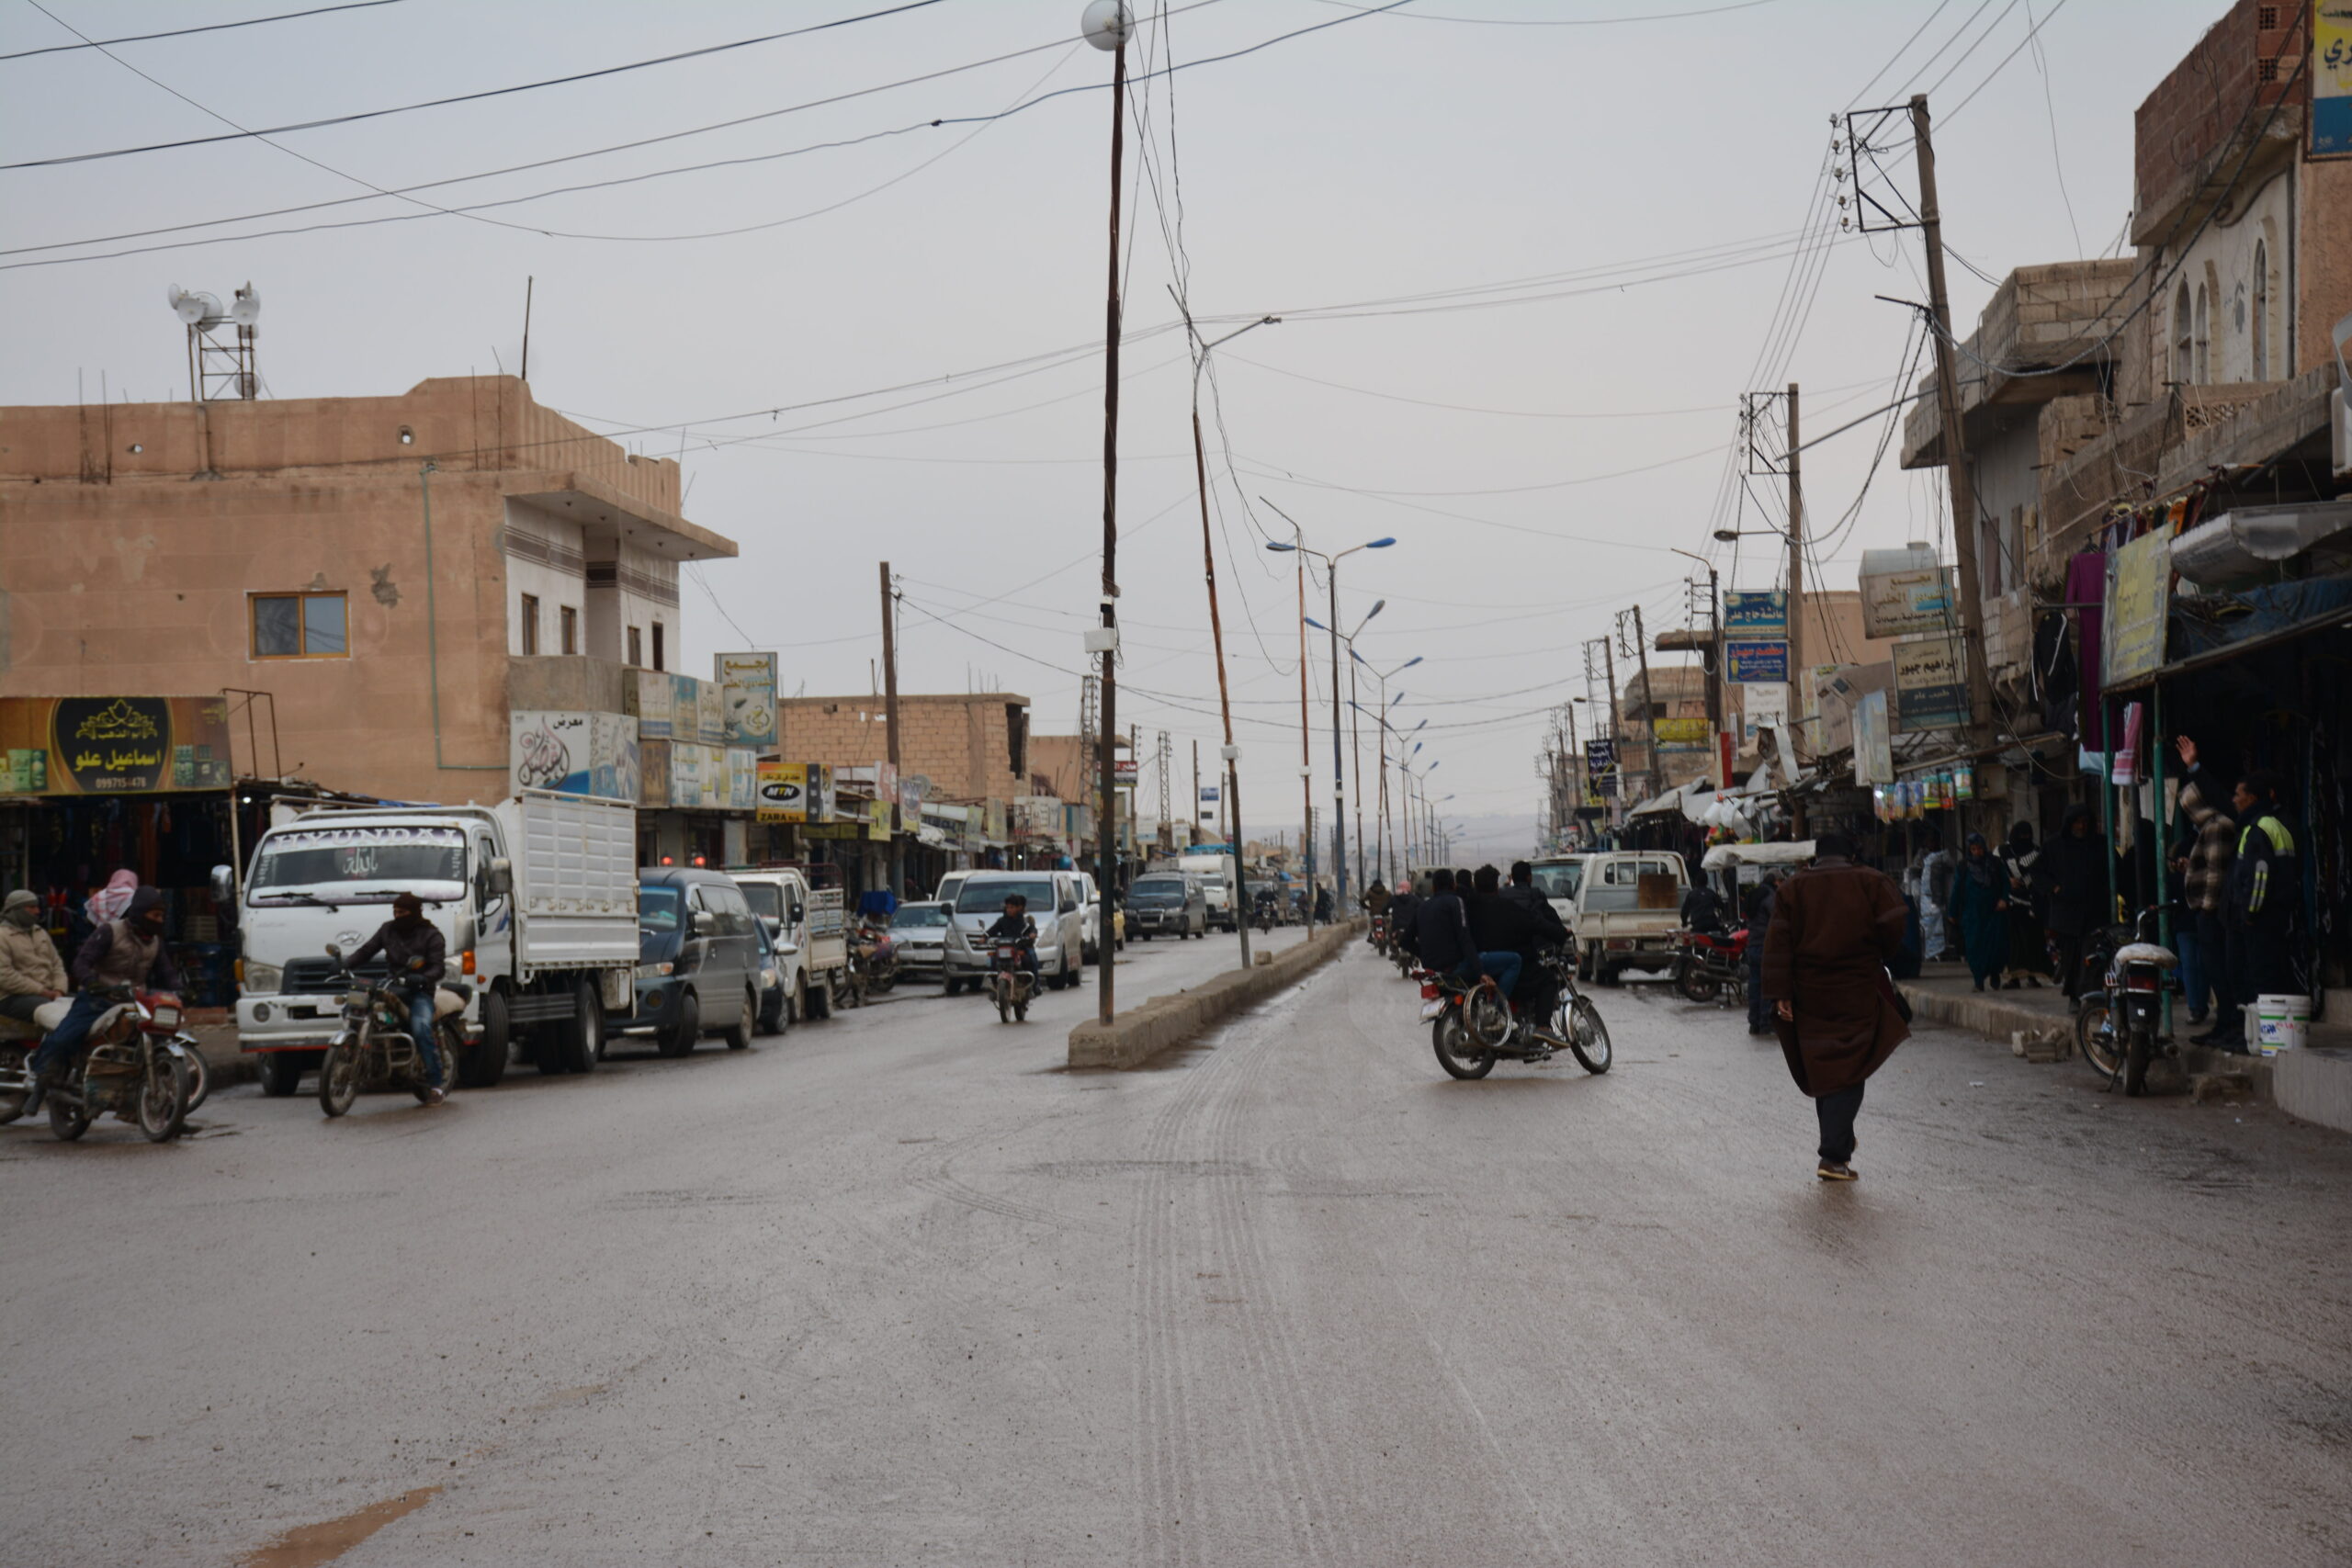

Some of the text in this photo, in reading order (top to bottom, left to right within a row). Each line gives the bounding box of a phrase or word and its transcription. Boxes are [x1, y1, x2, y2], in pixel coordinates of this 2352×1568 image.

[553, 714, 583, 729] معرض
[105, 748, 162, 772] اسماعيل
[766, 786, 795, 796] MTN
[761, 812, 786, 821] ZARA
[275, 828, 457, 852] HYUNDAI
